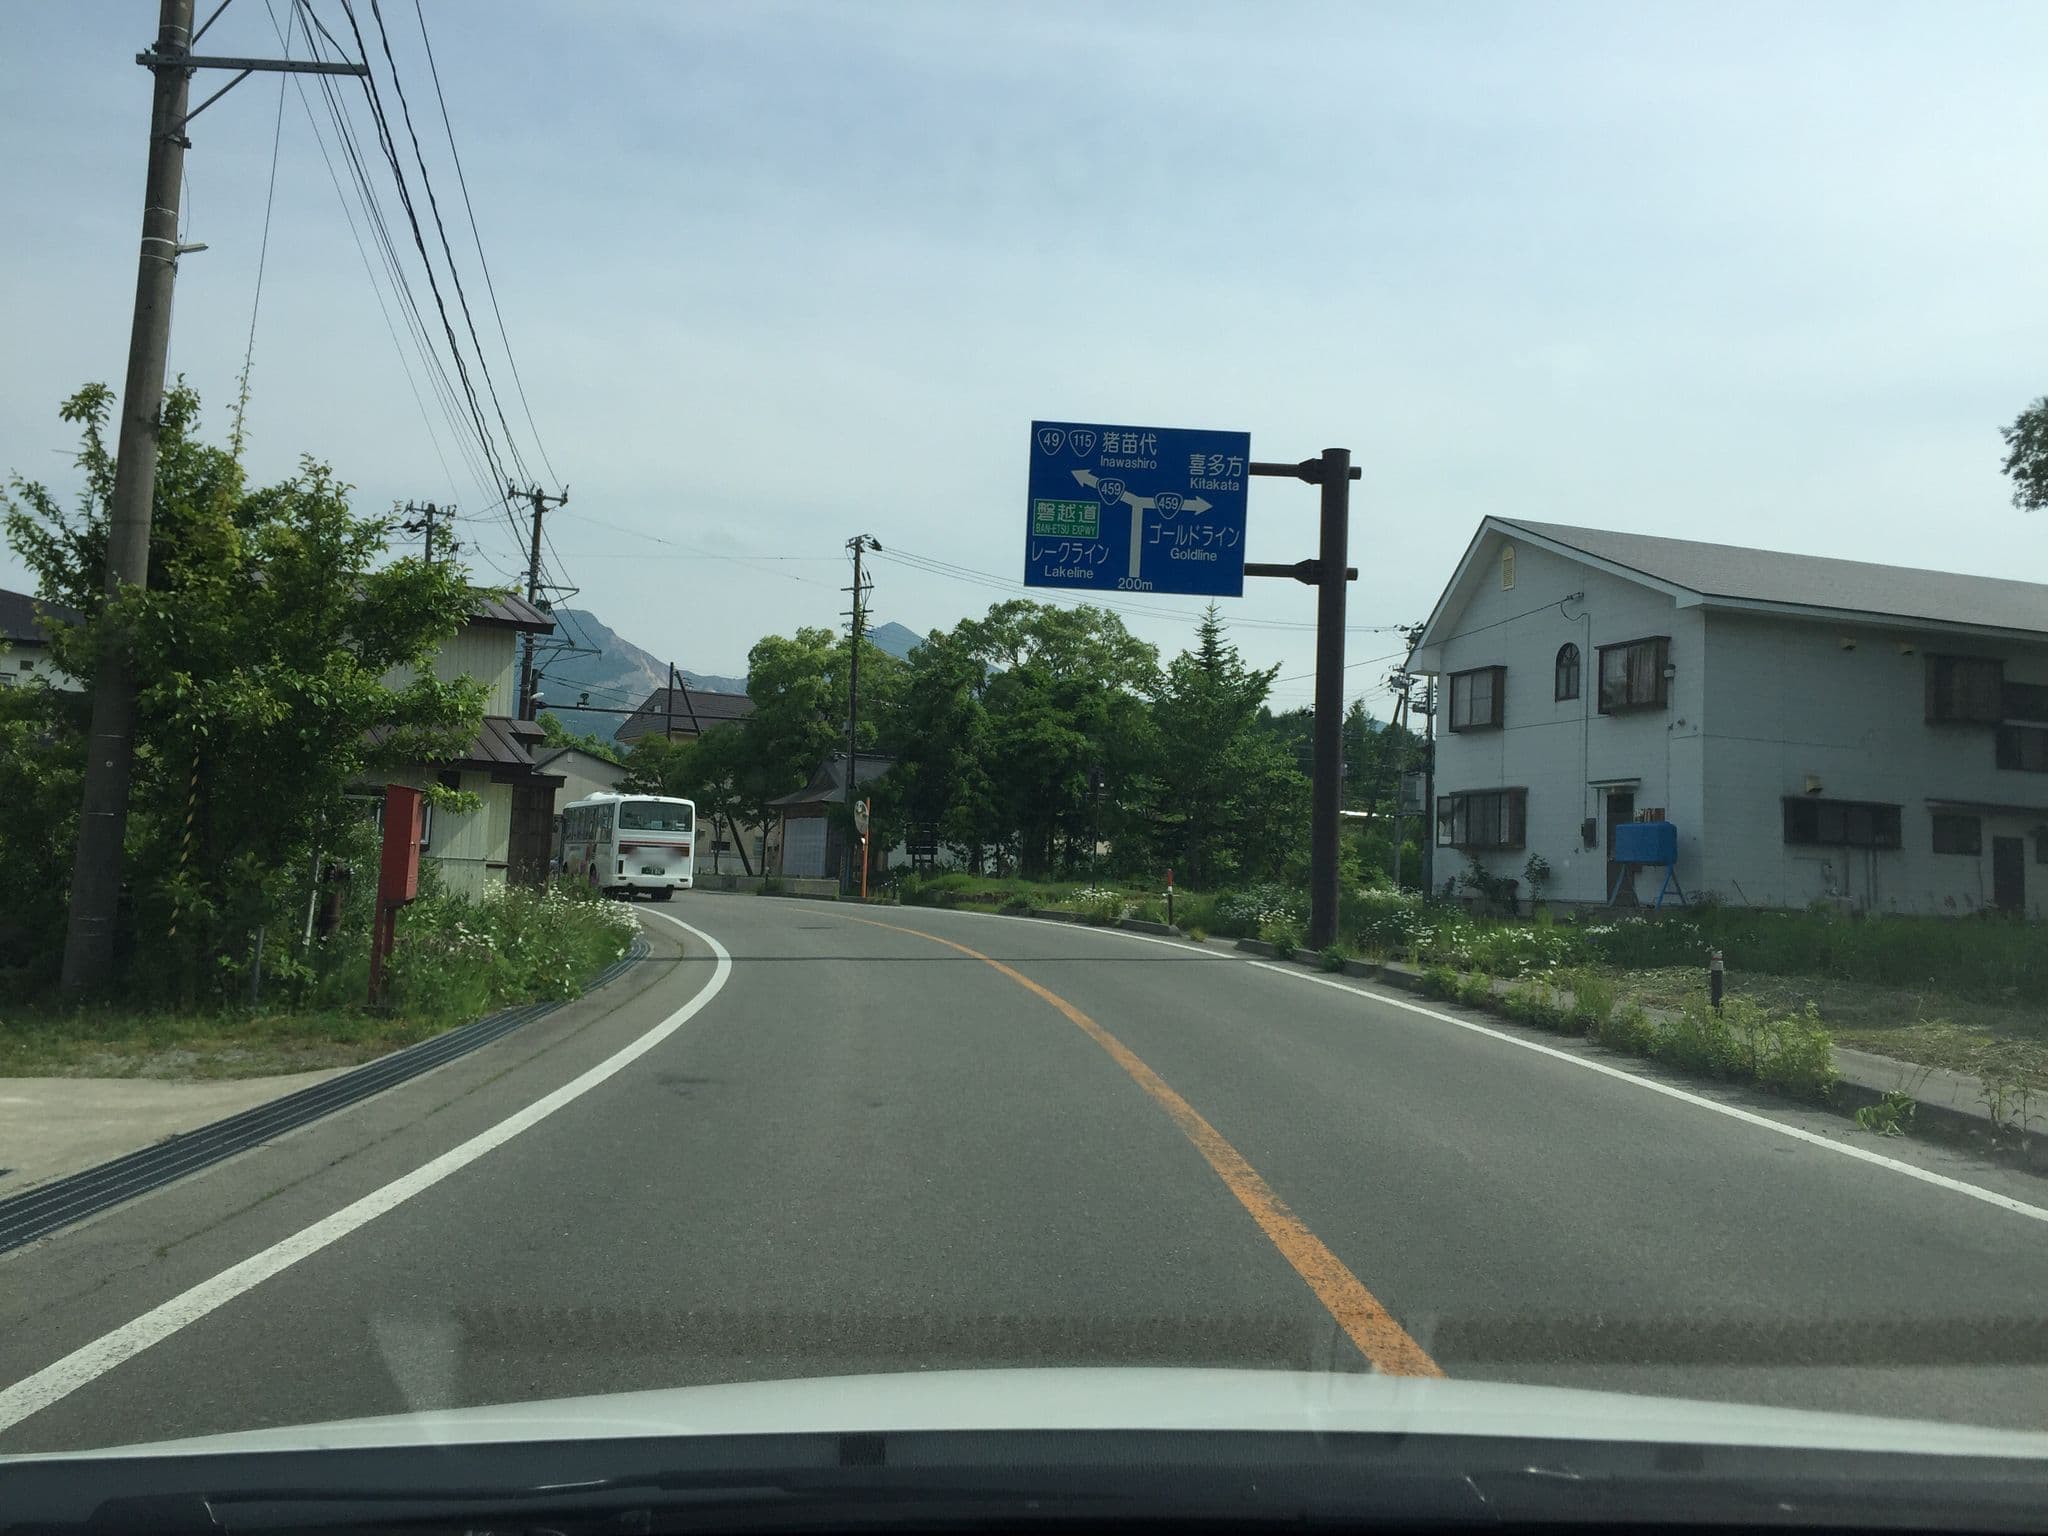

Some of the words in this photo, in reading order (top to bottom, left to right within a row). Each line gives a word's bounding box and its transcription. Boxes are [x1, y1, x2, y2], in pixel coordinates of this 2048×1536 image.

[1043, 432, 1060, 447] 49
[1073, 434, 1092, 448] 115
[1102, 431, 1157, 455] 猪苗代
[1100, 455, 1158, 470] Inawashiro
[1189, 453, 1244, 477] 喜多方
[1101, 482, 1121, 496] 459
[1190, 477, 1240, 492] Kitakata
[1158, 496, 1179, 510] 459
[1037, 502, 1097, 523] 磐越道
[1149, 523, 1240, 548] ゴールドライン
[1032, 541, 1109, 564] レークライン
[1170, 547, 1218, 562] Goldline
[1044, 564, 1094, 579] Lakeline
[1118, 577, 1153, 591] 200m
